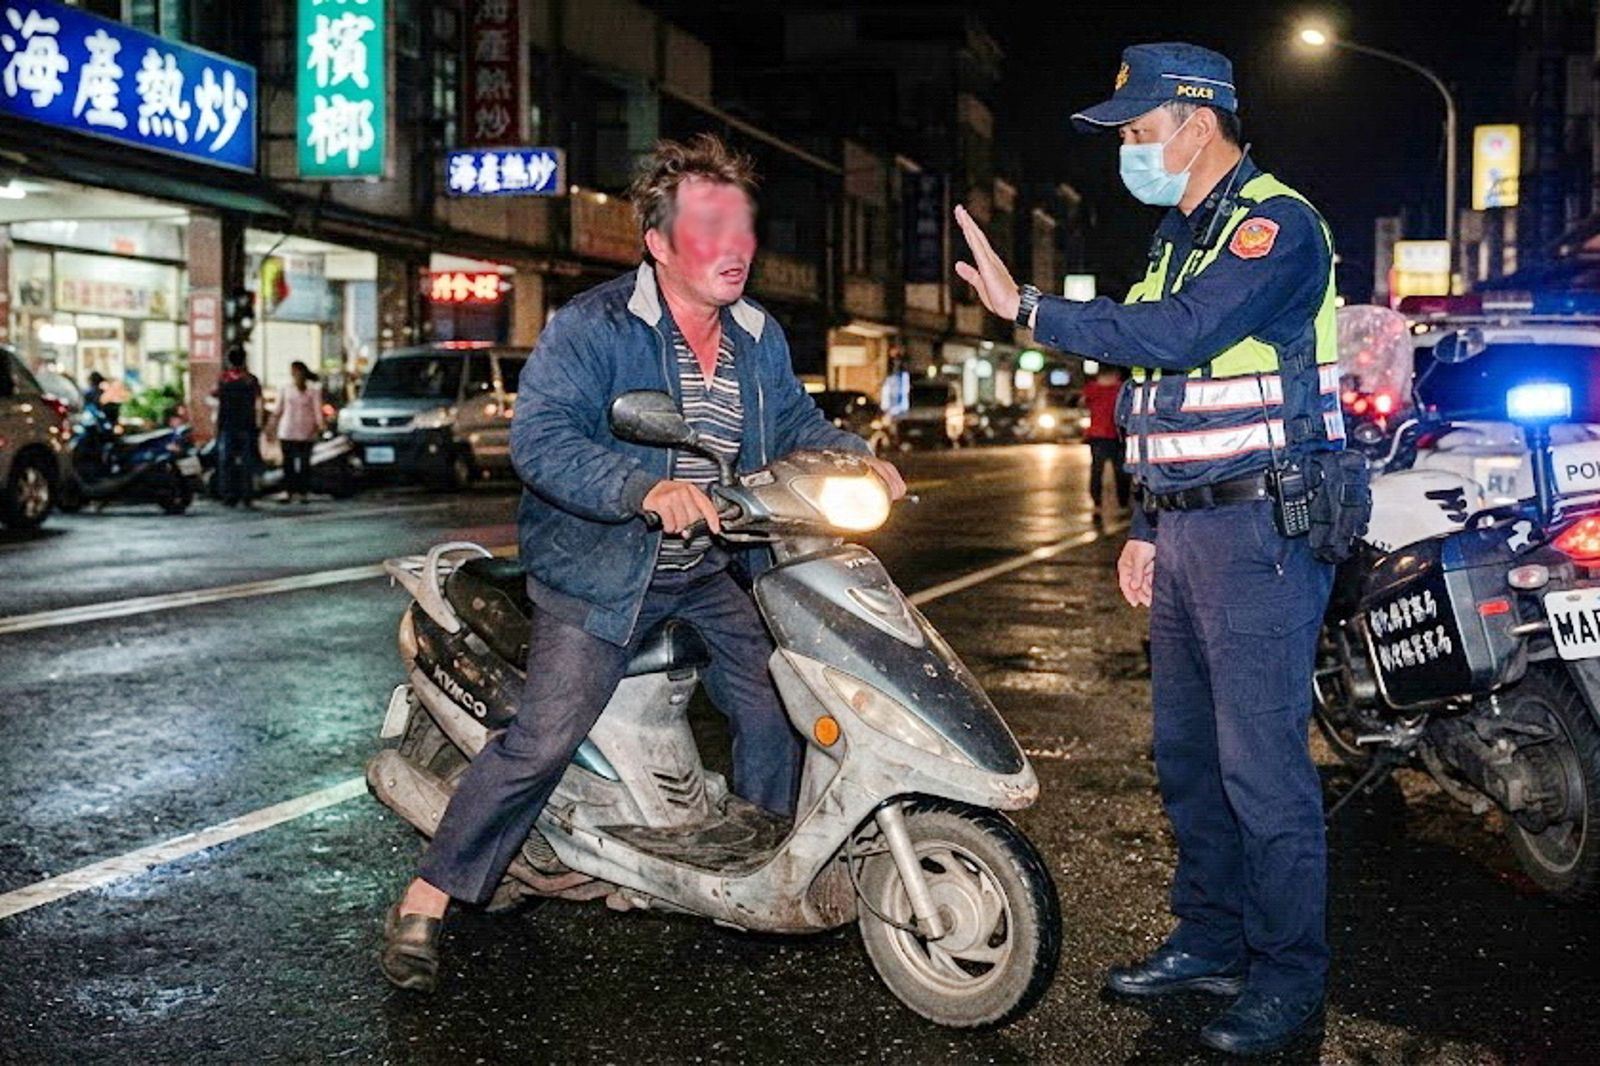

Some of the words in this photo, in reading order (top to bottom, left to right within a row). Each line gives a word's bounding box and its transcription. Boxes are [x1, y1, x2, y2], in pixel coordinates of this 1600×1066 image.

[2, 8, 248, 152] 海產熱炒
[307, 0, 375, 168] 檳榔
